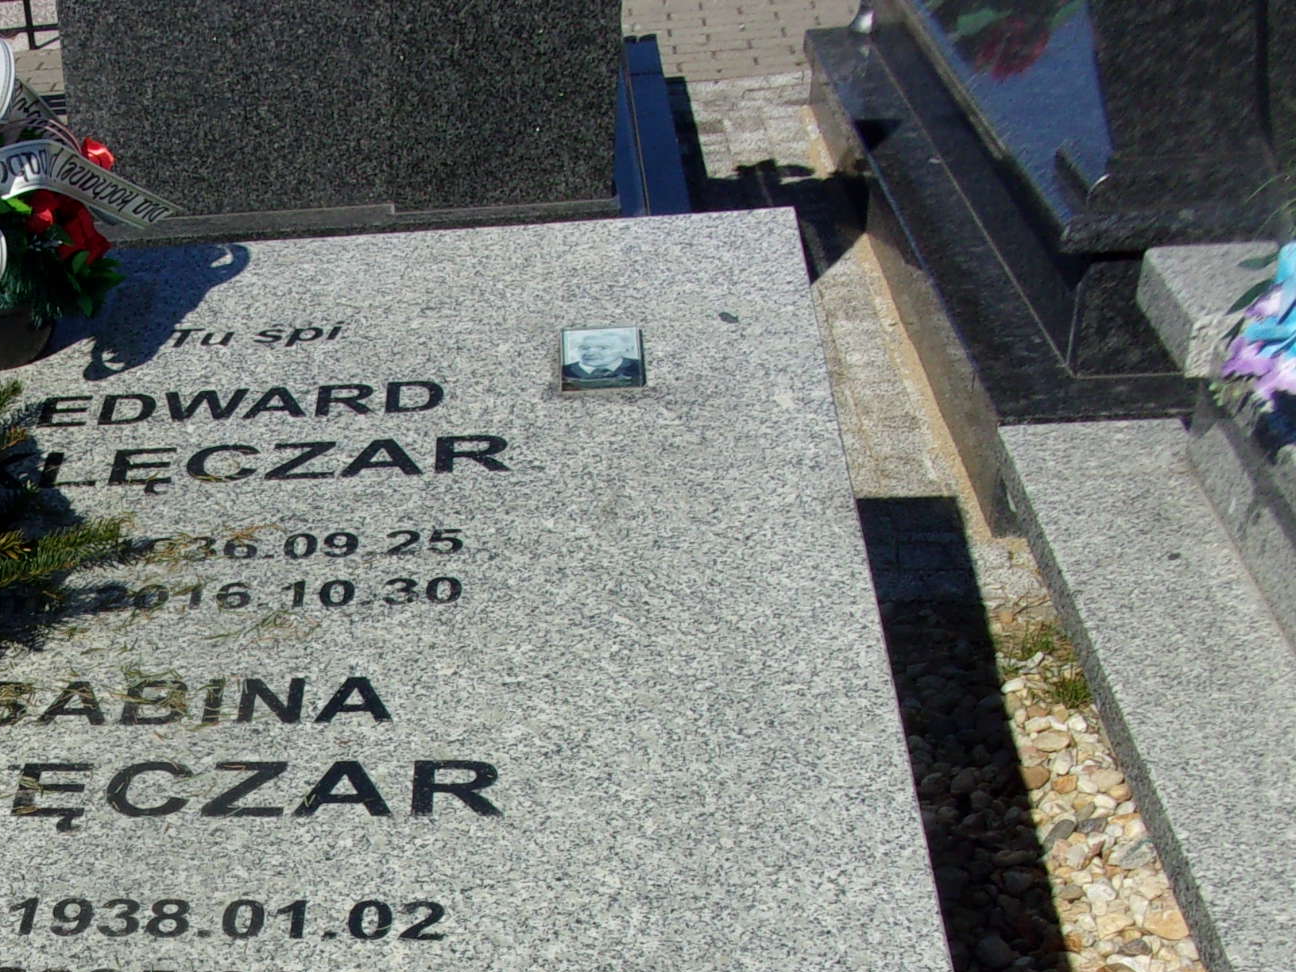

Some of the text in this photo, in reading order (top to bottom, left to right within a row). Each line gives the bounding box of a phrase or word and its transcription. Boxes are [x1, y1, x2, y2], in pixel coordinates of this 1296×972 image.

[171, 327, 235, 348] Tu
[35, 379, 447, 428] EDWARD
[9, 896, 448, 942] 1938.01.02
